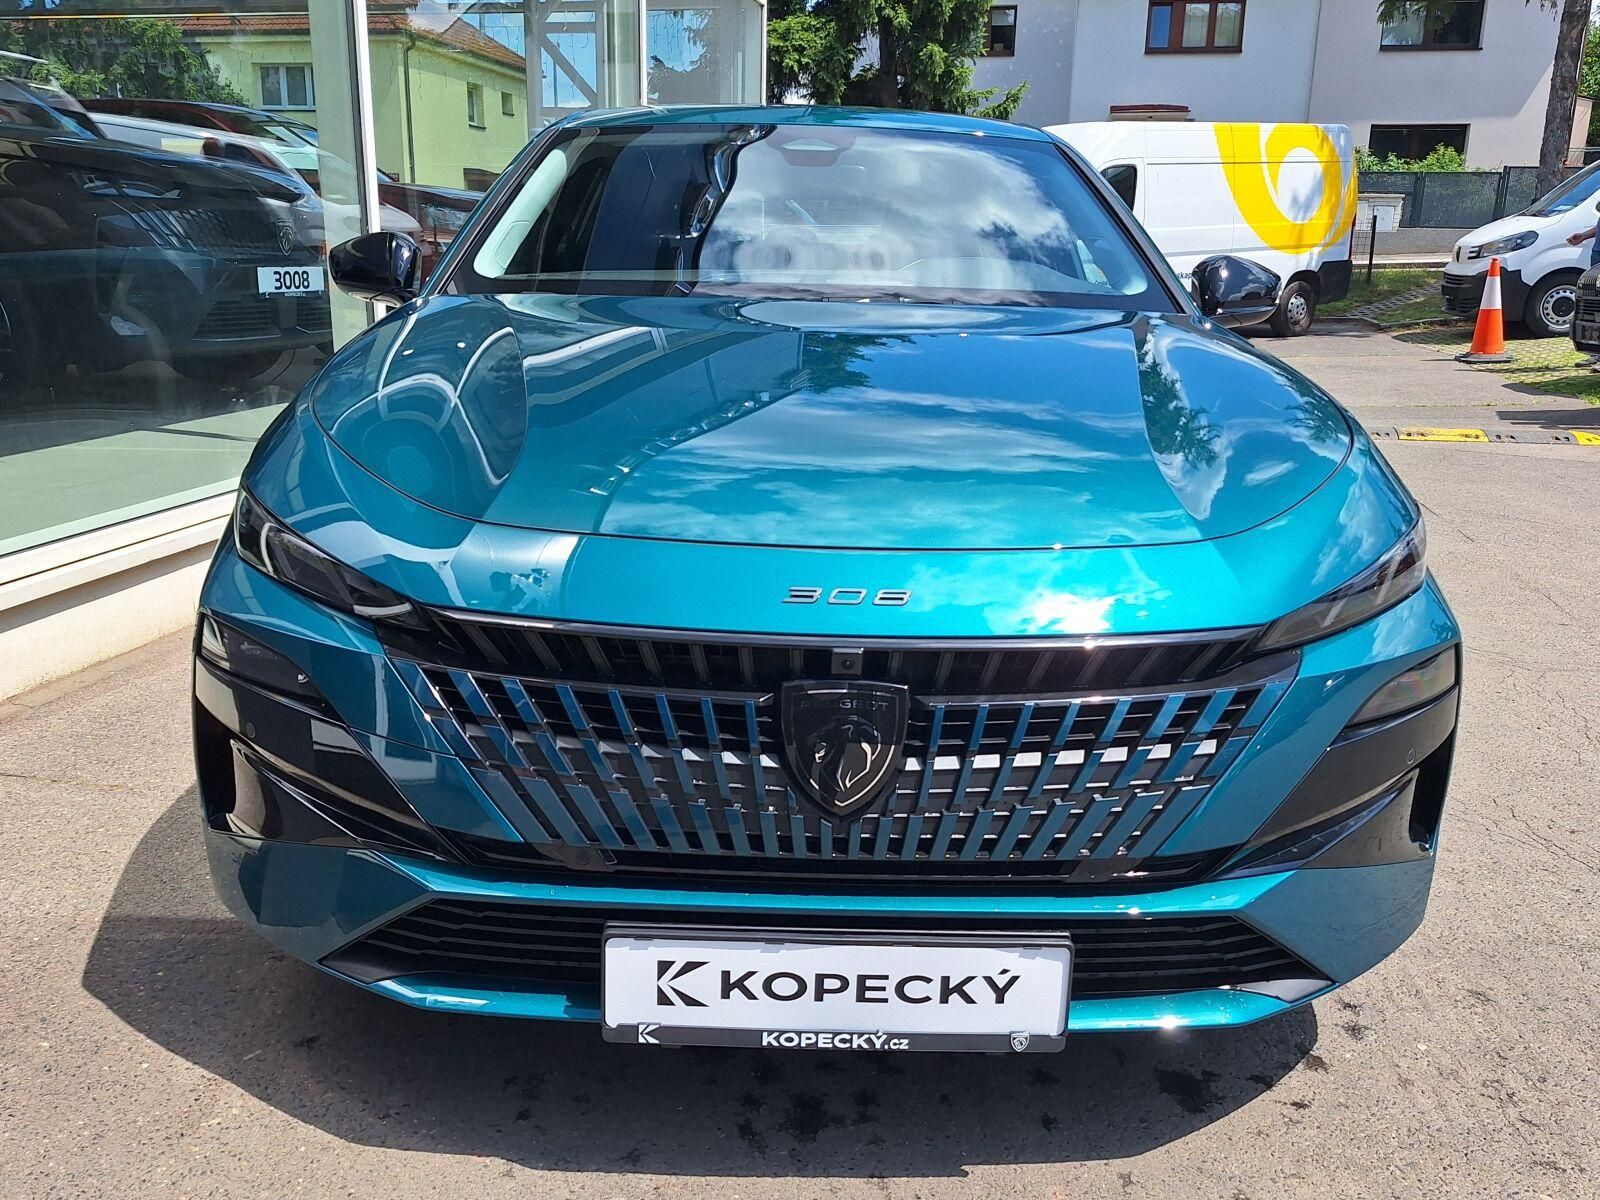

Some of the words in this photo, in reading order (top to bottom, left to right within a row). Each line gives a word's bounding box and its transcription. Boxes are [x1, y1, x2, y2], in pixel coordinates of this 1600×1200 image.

[273, 270, 310, 290] 3008
[781, 586, 912, 607] 308
[720, 968, 1021, 1005] KOPECKÝ
[761, 1029, 909, 1050] KOPECKÝ.cz
